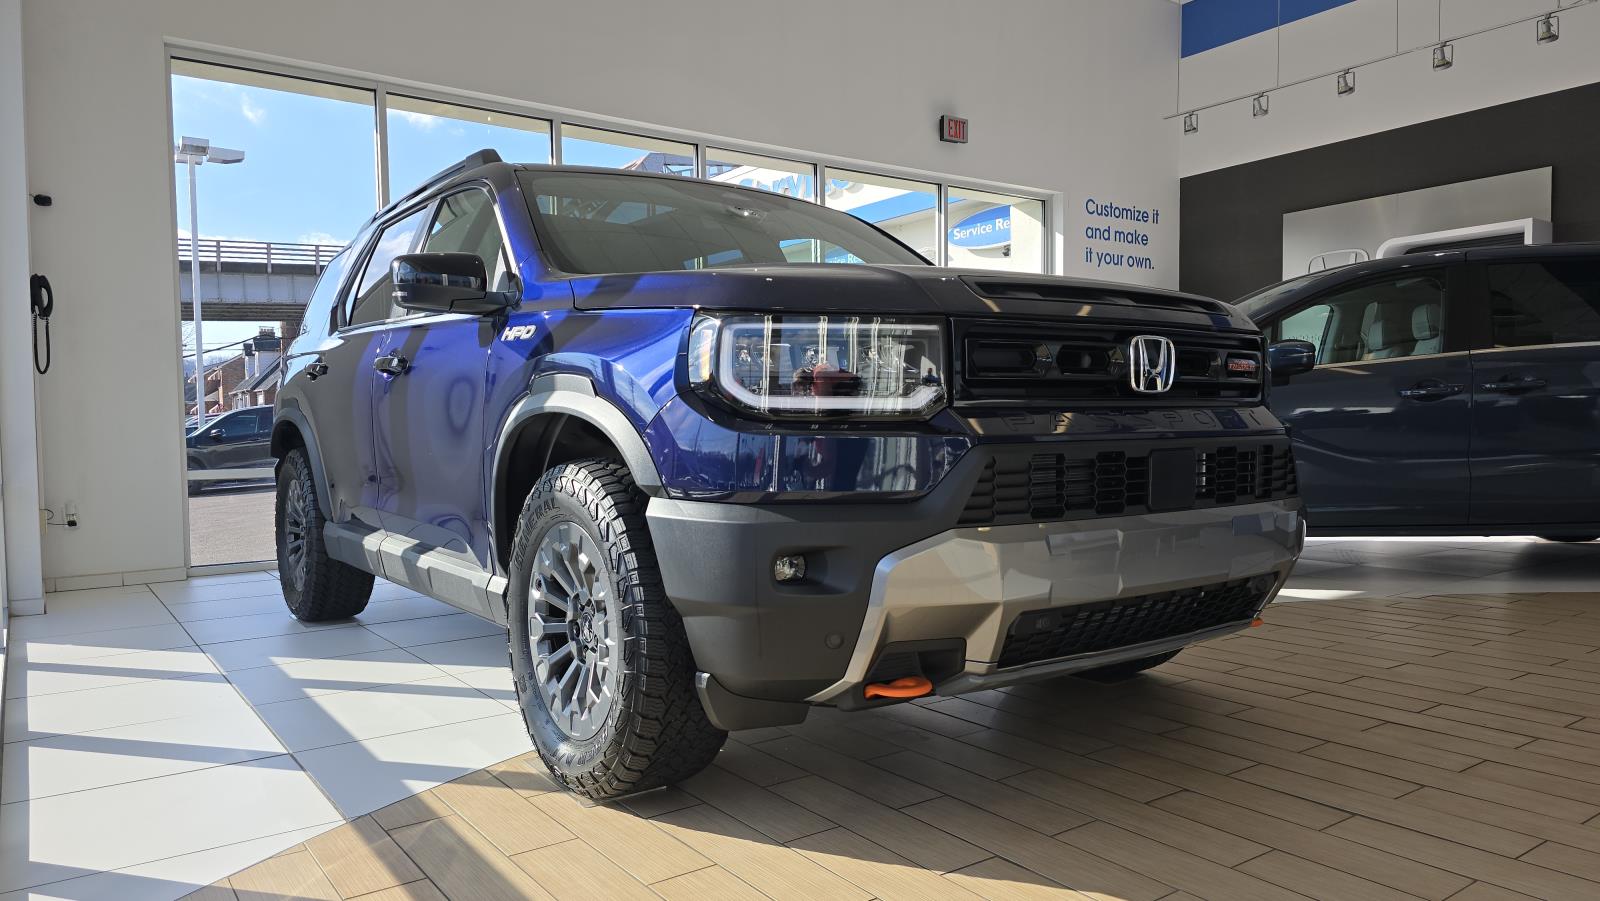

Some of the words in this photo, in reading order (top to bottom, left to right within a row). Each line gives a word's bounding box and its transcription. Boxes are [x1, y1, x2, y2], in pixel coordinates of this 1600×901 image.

[948, 118, 966, 140] EXIT
[1085, 198, 1149, 223] Customize
[1152, 208, 1159, 224] it
[953, 223, 993, 240] Service
[1085, 226, 1111, 241] and
[1114, 229, 1149, 246] make
[1085, 247, 1093, 263] it
[1096, 250, 1124, 268] your
[1127, 255, 1155, 270] own.
